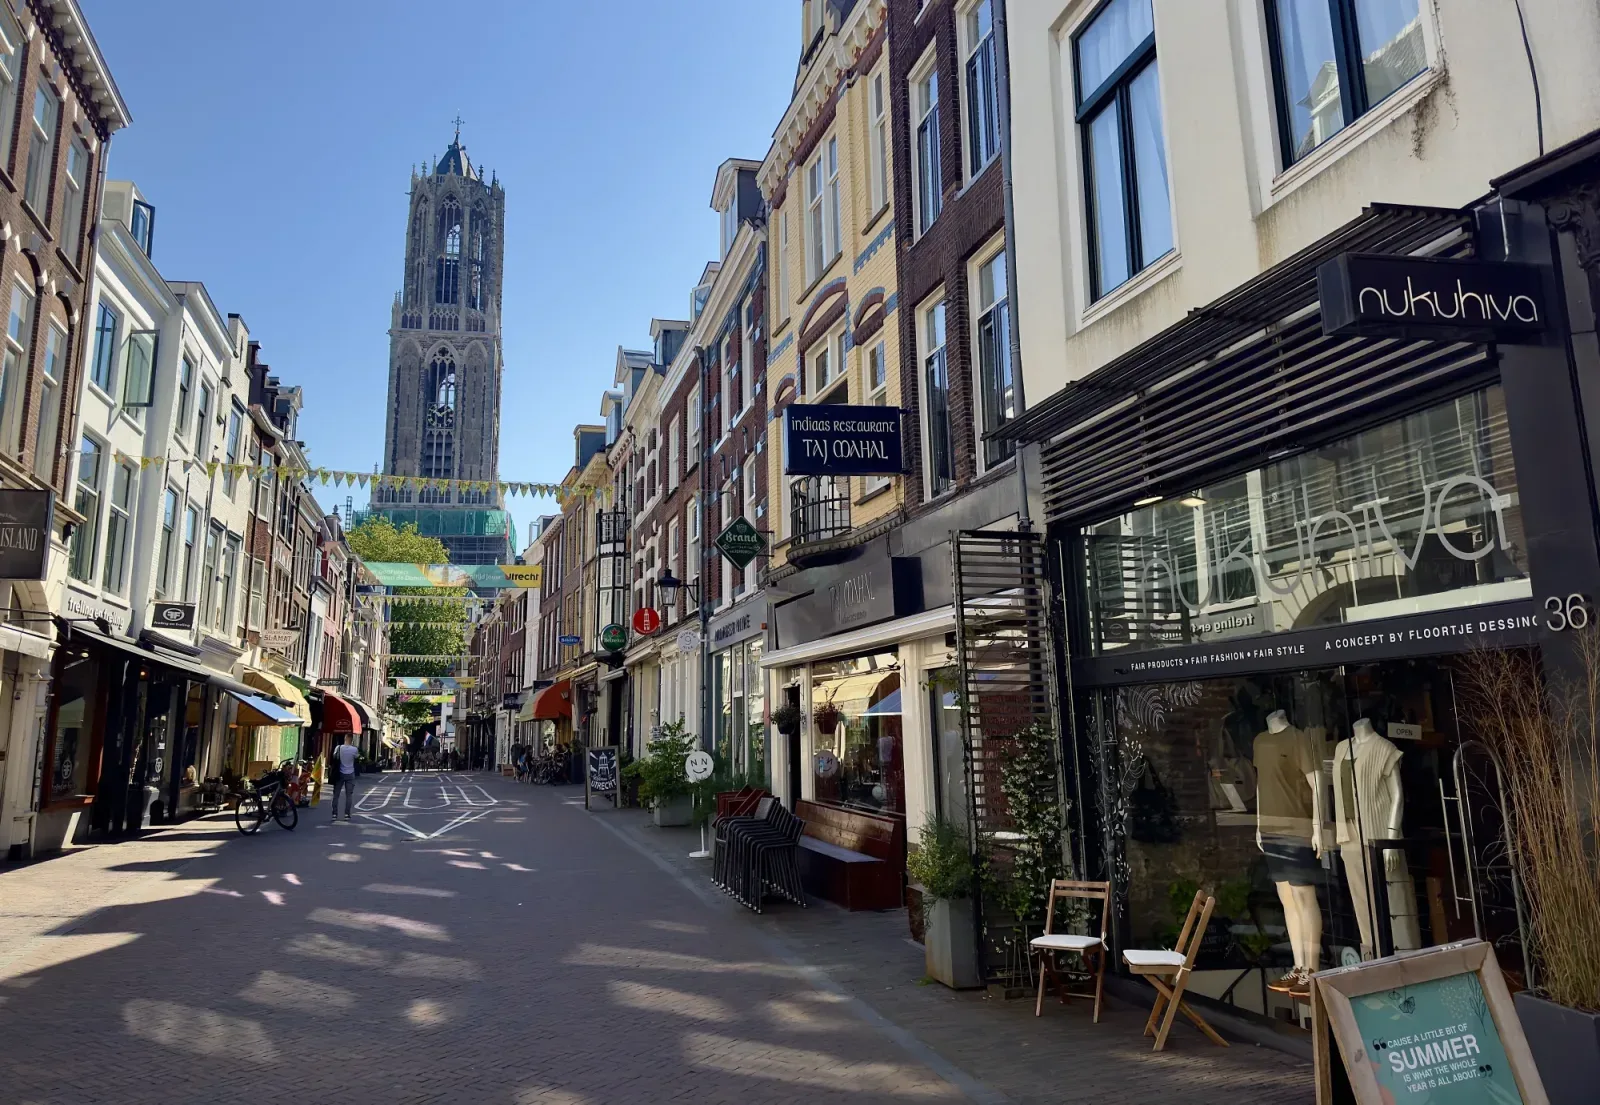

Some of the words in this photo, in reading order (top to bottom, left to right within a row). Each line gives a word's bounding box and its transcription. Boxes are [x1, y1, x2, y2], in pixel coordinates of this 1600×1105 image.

[1359, 276, 1538, 322] nukuhiva
[802, 439, 828, 465] TAJ
[832, 439, 889, 460] MAHAL
[0, 527, 38, 551] ISLAND
[725, 531, 758, 543] Brand
[1544, 593, 1588, 632] 36
[1325, 640, 1332, 650] A
[1335, 634, 1385, 649] CONCEPT
[1389, 632, 1404, 643] BY
[1409, 623, 1473, 641] FLOORTJE
[1131, 662, 1146, 671] FAIR
[1147, 658, 1183, 669] PRODUCTS
[1191, 656, 1208, 665] FAIR
[1210, 651, 1245, 663] FASHION
[1254, 648, 1274, 658] FAIR
[1276, 645, 1305, 656] STYLE
[1396, 728, 1413, 736] OPEN
[590, 778, 617, 790] UTRECHT
[1414, 1034, 1420, 1043] A
[1420, 1029, 1445, 1041] LITTLE
[1446, 1025, 1457, 1036] BIT
[1457, 1023, 1469, 1032] OF
[1388, 1034, 1480, 1073] SUMMER
[1403, 1075, 1412, 1083] IS
[1412, 1069, 1433, 1081] WHAT
[1434, 1065, 1450, 1075] THE
[1449, 1058, 1478, 1071] WHOLE
[1407, 1082, 1428, 1094] YEAR
[1428, 1080, 1437, 1088] IS
[1438, 1076, 1452, 1086] ALL
